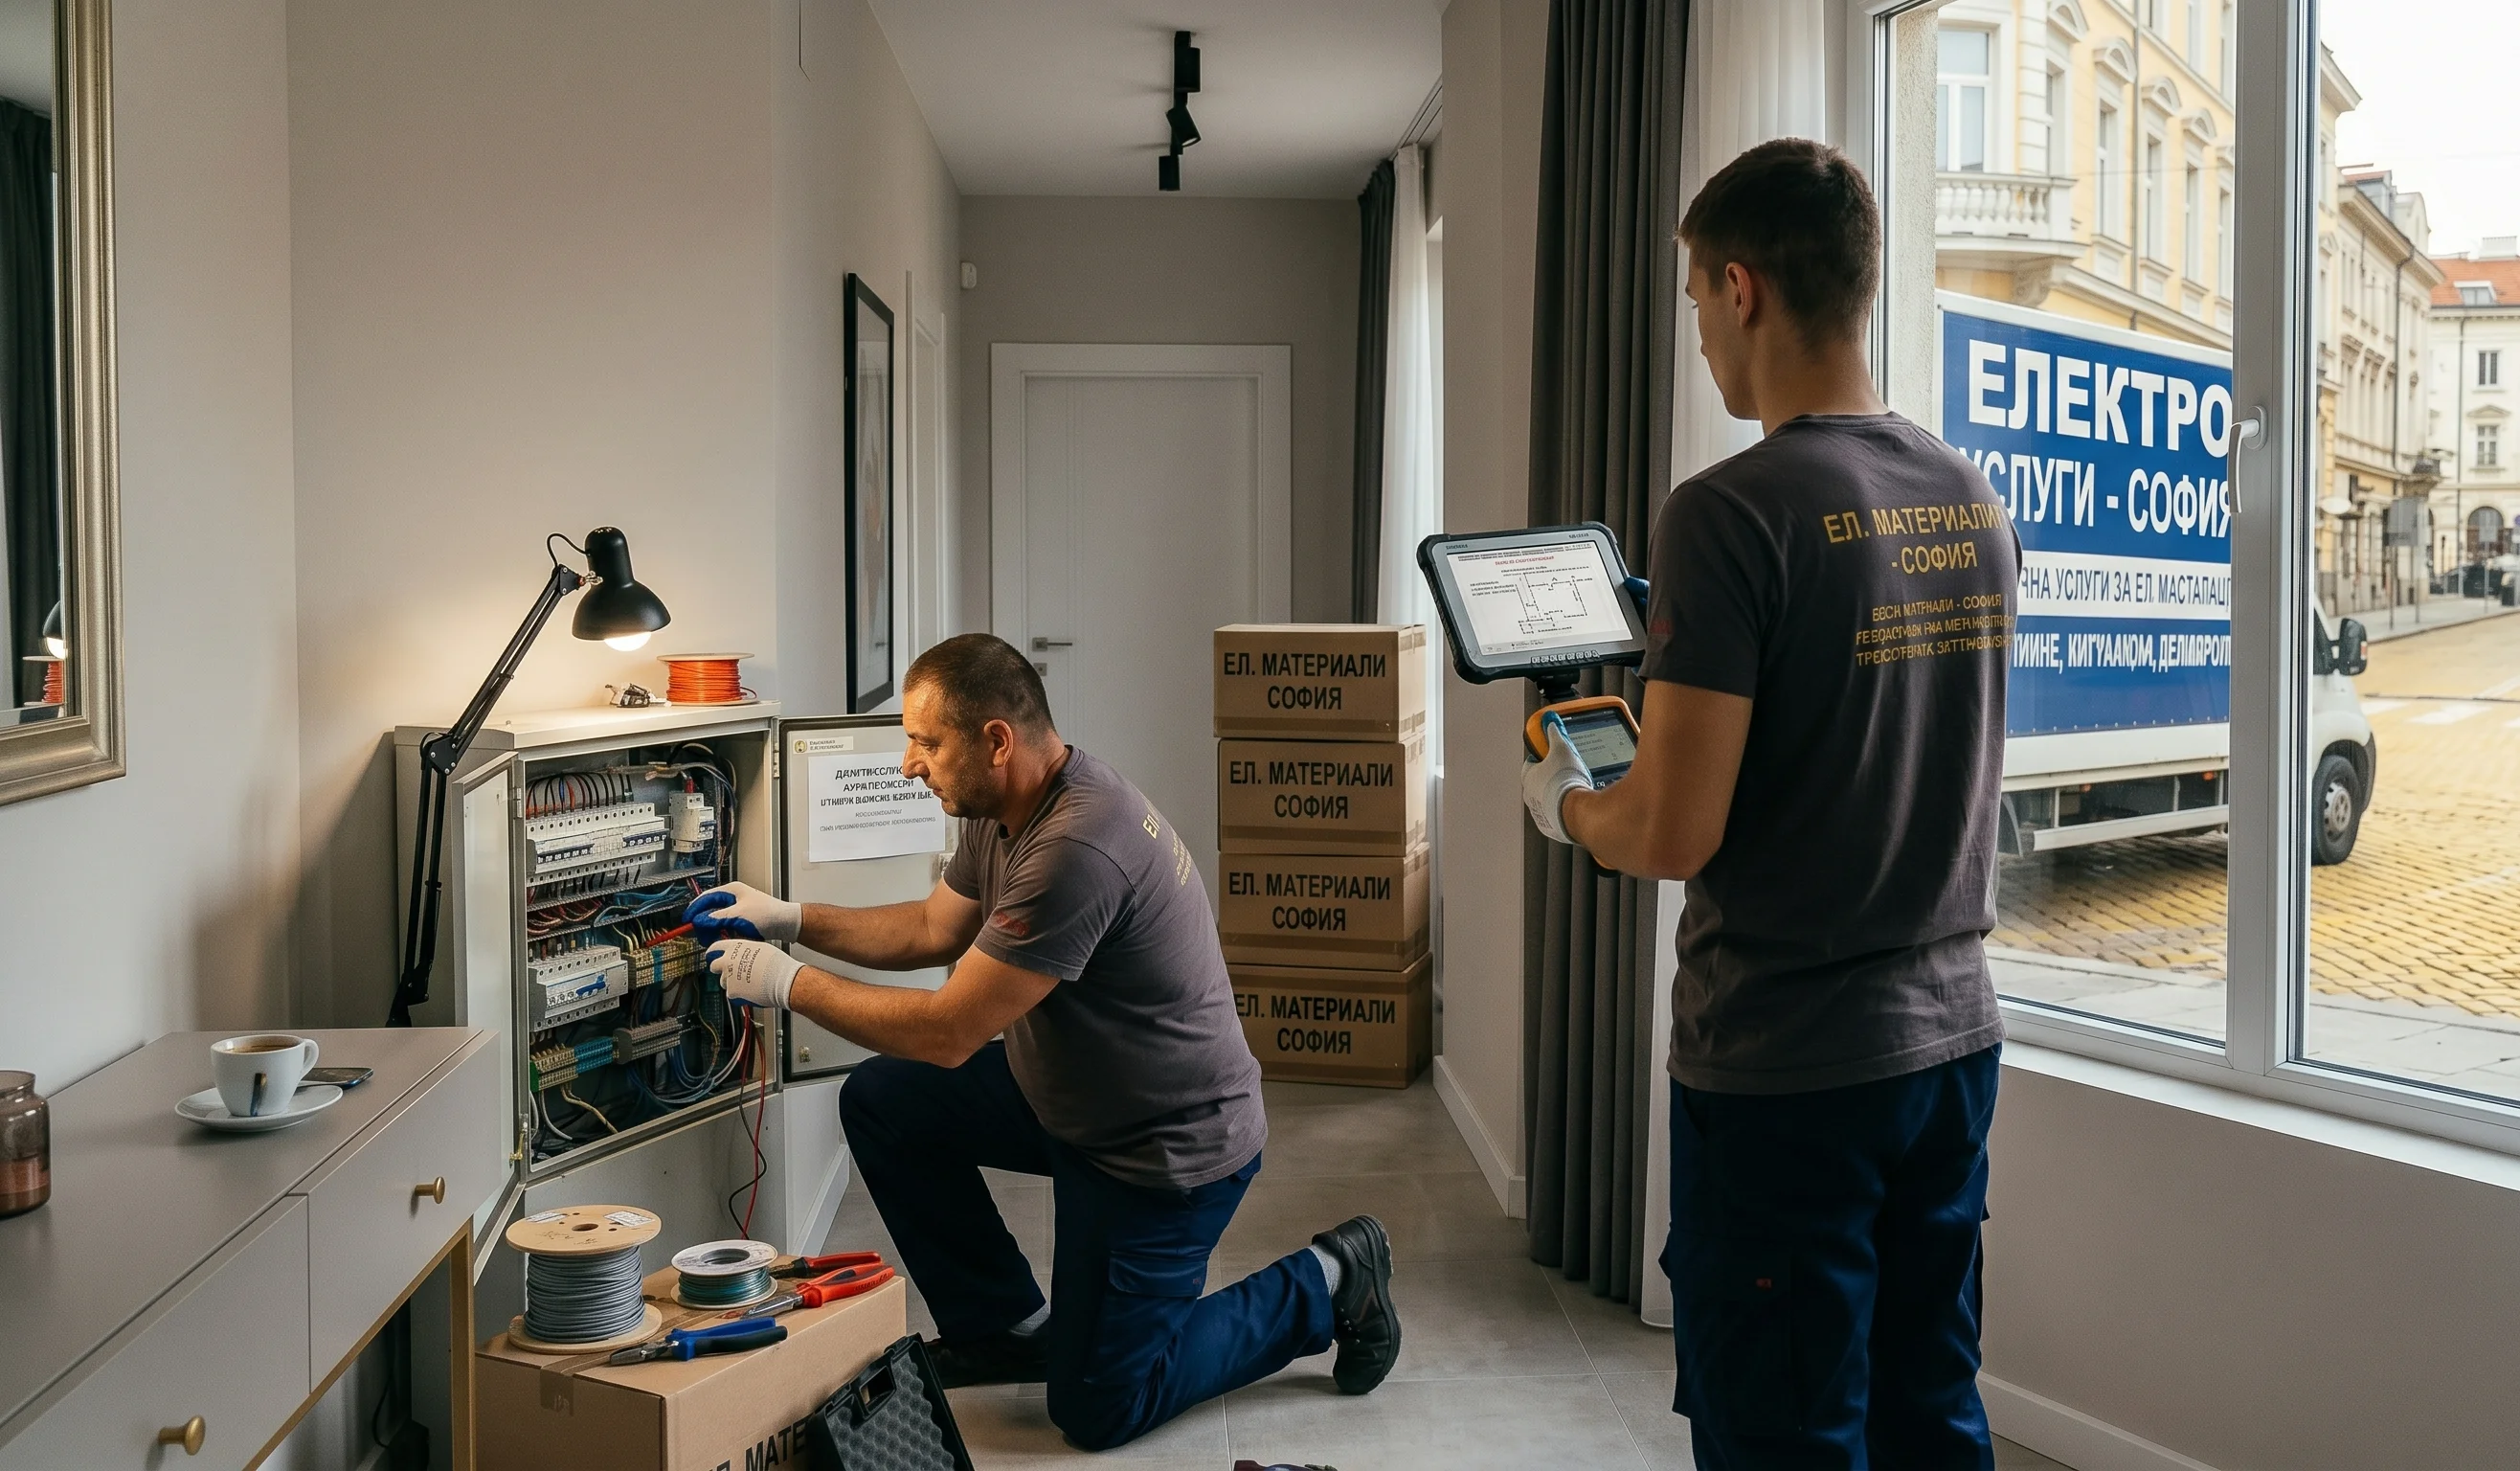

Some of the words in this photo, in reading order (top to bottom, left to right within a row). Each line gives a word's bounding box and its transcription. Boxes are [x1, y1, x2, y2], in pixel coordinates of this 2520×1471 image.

[1969, 338, 2232, 458] ЕЛЕКТРО
[2128, 468, 2232, 537] СОФИЯ
[1823, 511, 1869, 544] ЕЛ.
[2056, 568, 2109, 601] УСЛУГИ
[2114, 571, 2131, 602] ЗА
[1224, 652, 1255, 676] ЕЛ.
[1262, 653, 1385, 677] МАТЕРИАЛИ
[1268, 686, 1341, 710] СОФИЯ
[1230, 761, 1261, 784] ЕЛ.
[1269, 761, 1393, 787] МАТЕРИАЛИ
[1274, 795, 1348, 819] СОФИЯ
[1229, 872, 1260, 895] ЕЛ.
[1267, 873, 1390, 900] МАТЕРИАЛИ
[1272, 906, 1346, 931] СОФИЯ
[1234, 994, 1265, 1017] ЕЛ.
[1271, 996, 1395, 1024] МАТЕРИАЛИ
[1277, 1028, 1351, 1054] СОФИЯ
